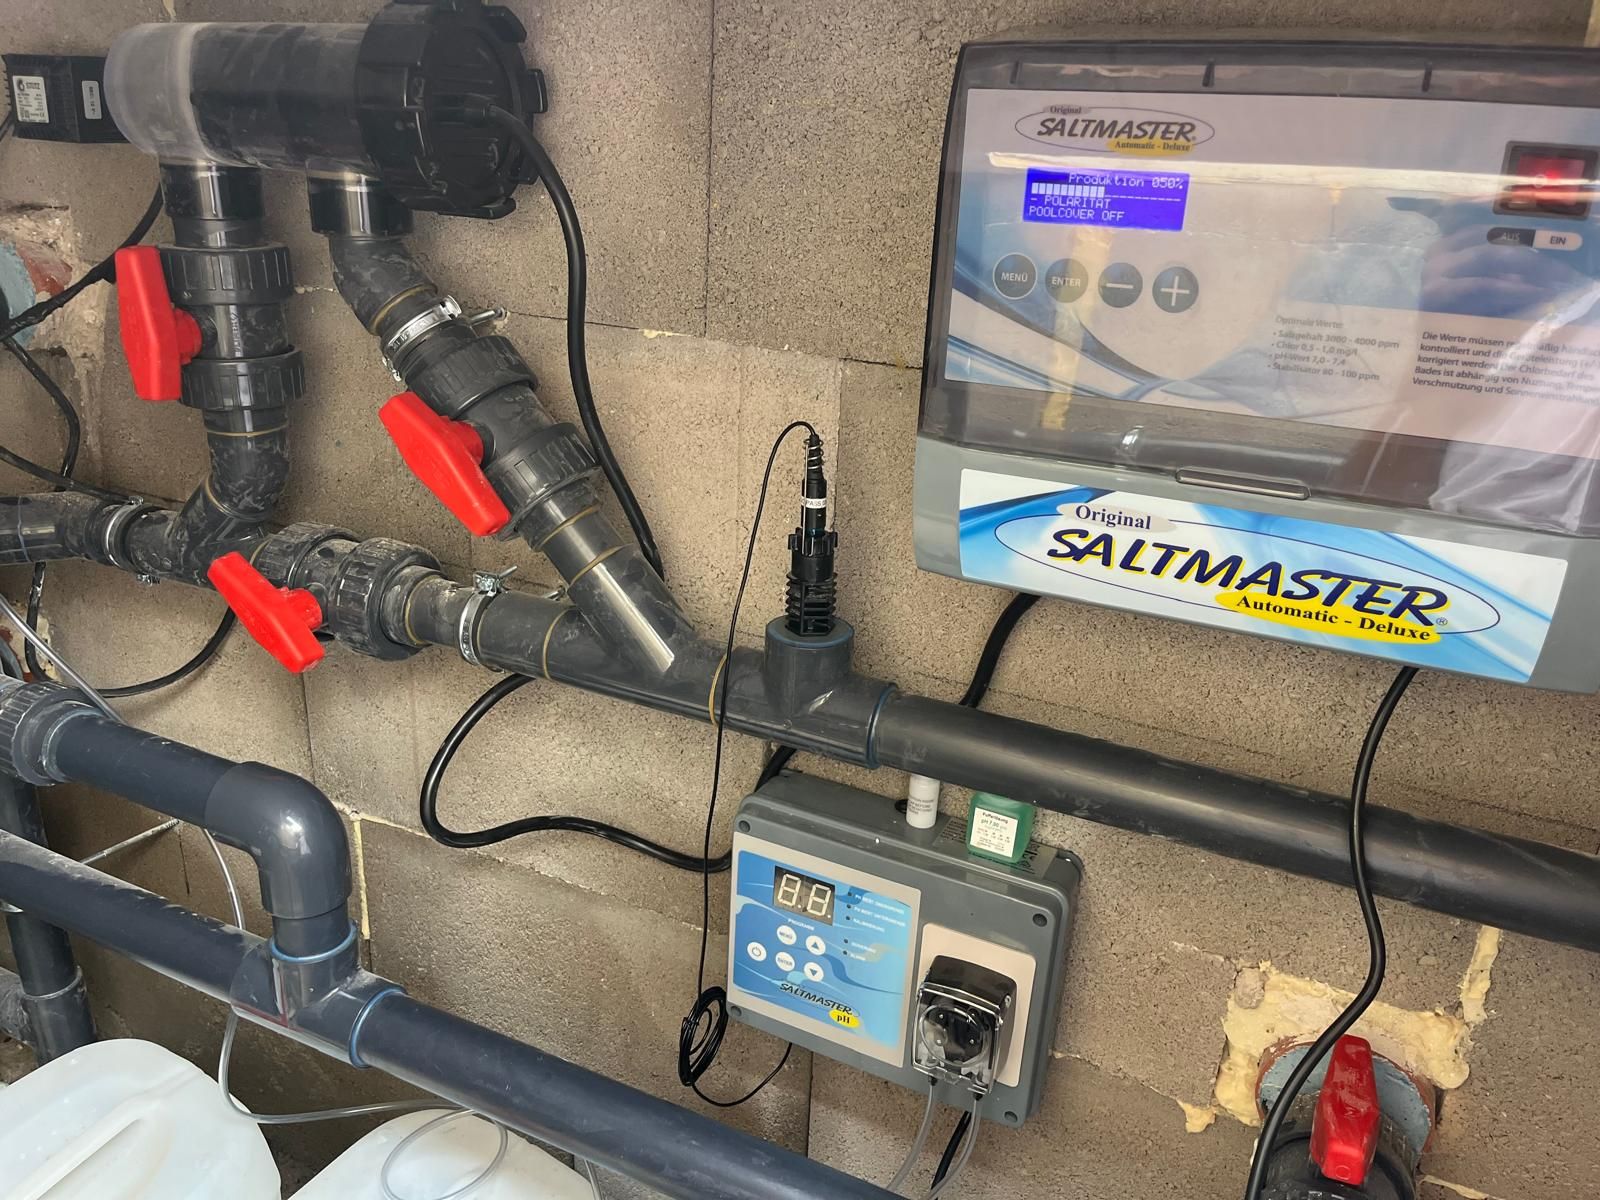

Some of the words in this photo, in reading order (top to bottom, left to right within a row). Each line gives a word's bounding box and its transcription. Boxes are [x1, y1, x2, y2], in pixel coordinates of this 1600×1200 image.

[1050, 105, 1082, 115] Original
[1115, 141, 1156, 150] Automatic
[1163, 143, 1190, 151] Deluxe
[1068, 173, 1145, 188] Produktion
[1151, 176, 1184, 190] 050%
[1028, 206, 1095, 220] POOLCOVER
[1101, 210, 1125, 222] OFF
[1549, 235, 1567, 245] EIN
[1001, 270, 1028, 282] MENÜ
[1051, 276, 1081, 288] ENTER
[1422, 331, 1438, 340] Die
[1440, 333, 1467, 343] Werte
[1469, 336, 1504, 346] müssen
[1276, 341, 1300, 350] Chlor
[1420, 343, 1470, 355] kontrolliert
[1472, 349, 1492, 358] und
[1417, 354, 1459, 366] korrigiert
[1415, 366, 1442, 376] Bades
[1443, 369, 1454, 377] ist
[1412, 377, 1483, 393] Verschmutzung
[1484, 386, 1504, 394] und
[1075, 504, 1152, 531] Original
[1047, 528, 1448, 627] SALTMASTER
[1237, 595, 1339, 625] Automatic
[1358, 615, 1431, 641] Deluxe
[780, 983, 853, 1016] SALTMASTER
[837, 1014, 850, 1024] pH
